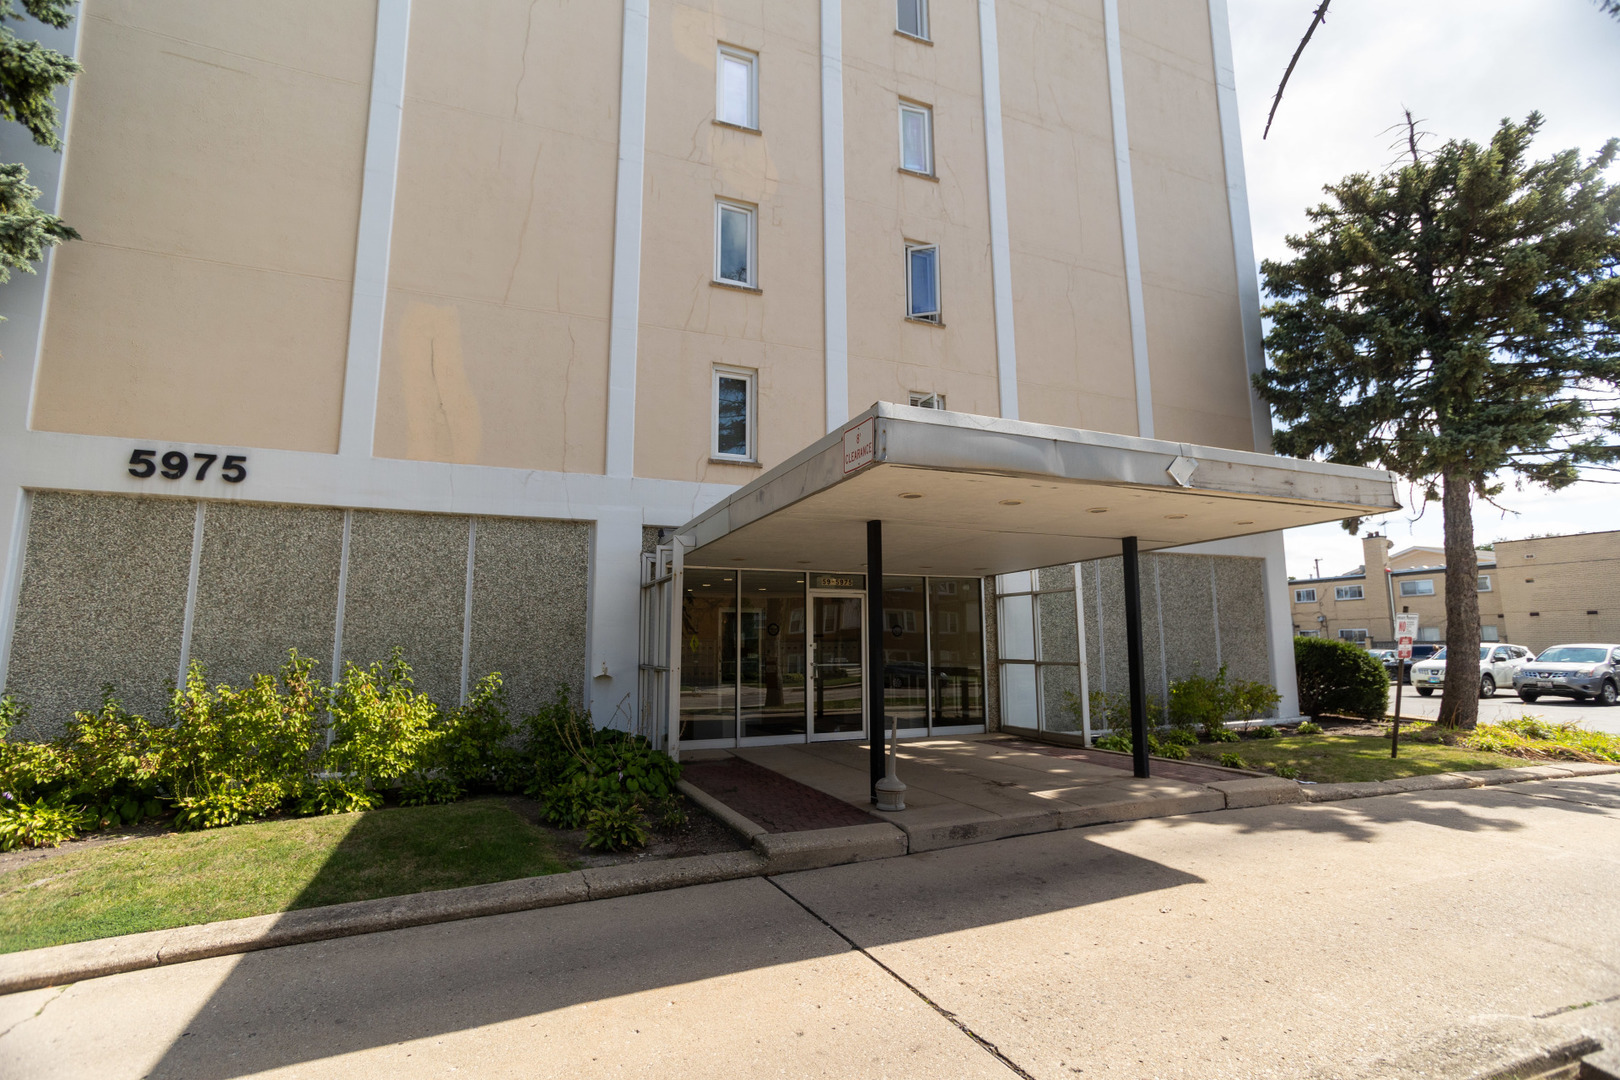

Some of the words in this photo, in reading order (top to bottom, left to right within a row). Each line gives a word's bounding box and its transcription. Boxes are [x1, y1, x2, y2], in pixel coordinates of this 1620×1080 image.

[846, 442, 872, 464] CLEARANCE
[128, 449, 246, 482] 5975
[1399, 621, 1406, 632] NO
